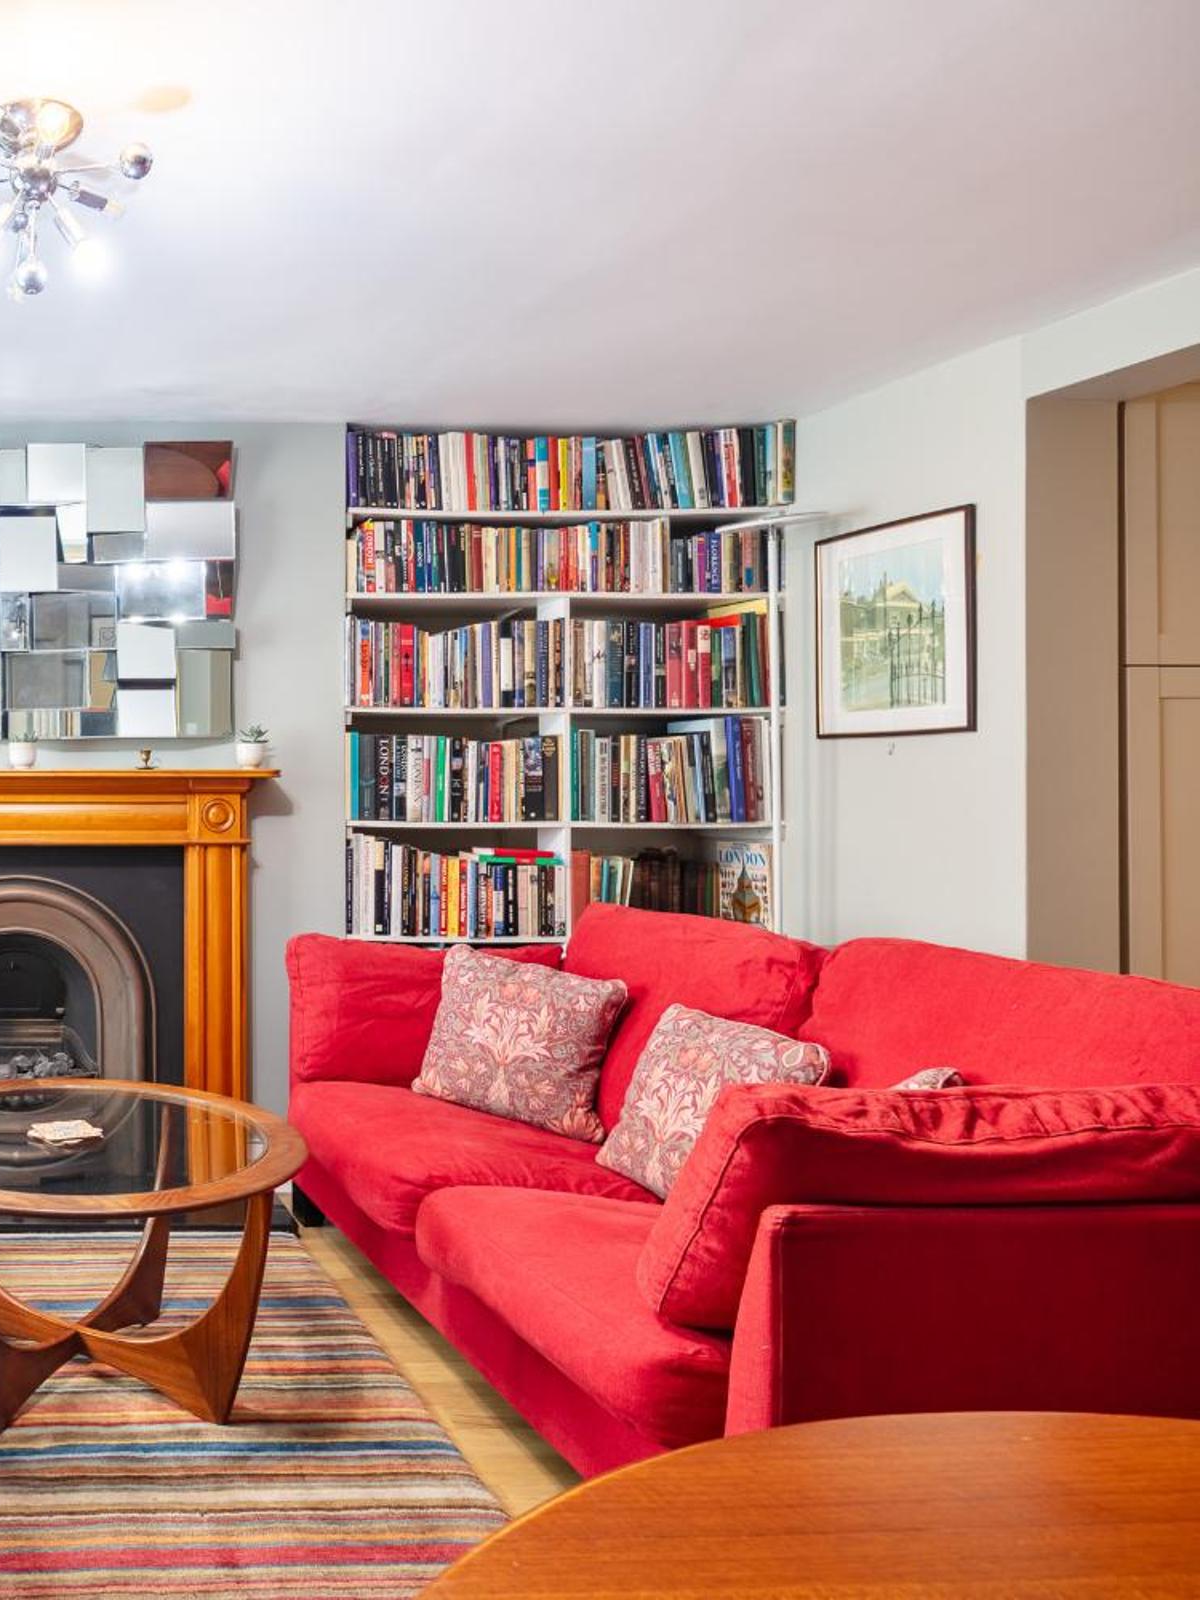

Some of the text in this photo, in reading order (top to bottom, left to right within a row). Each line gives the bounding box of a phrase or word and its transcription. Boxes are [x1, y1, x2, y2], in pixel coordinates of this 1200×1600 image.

[710, 538, 719, 585] FLORENCE
[378, 738, 390, 795] LONDON
[719, 848, 767, 867] LONDON
